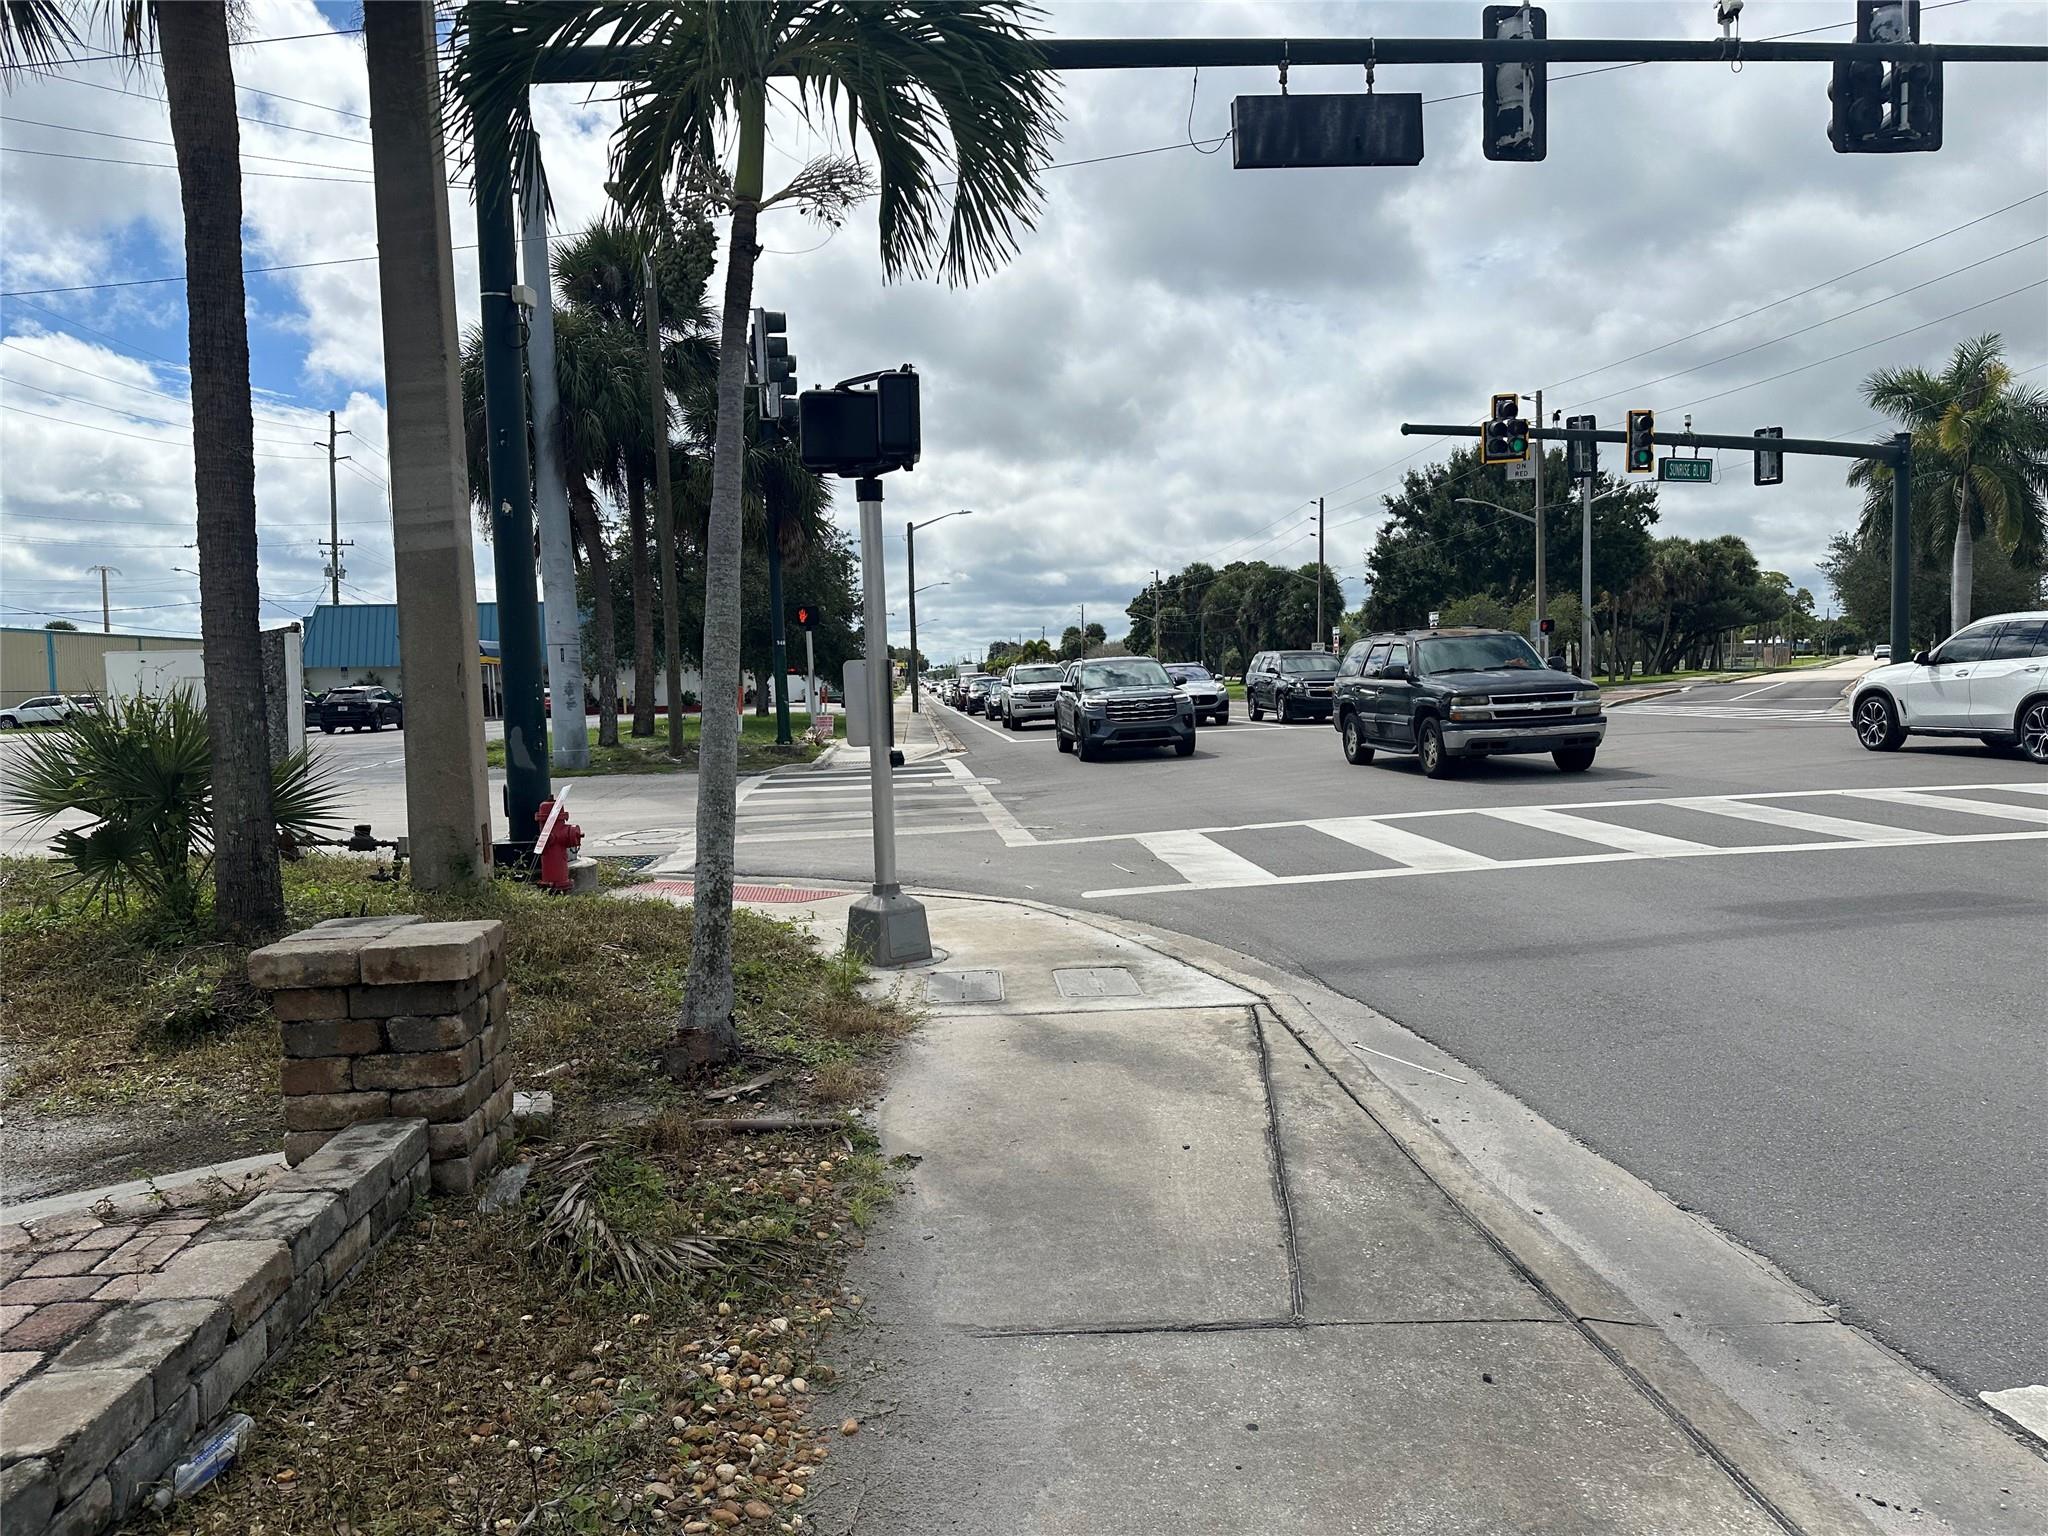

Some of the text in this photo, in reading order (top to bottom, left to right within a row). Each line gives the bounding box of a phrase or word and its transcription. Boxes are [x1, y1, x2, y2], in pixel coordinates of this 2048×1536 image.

[1514, 470, 1529, 478] RED
[1669, 463, 1707, 477] SUNRISE BLVD
